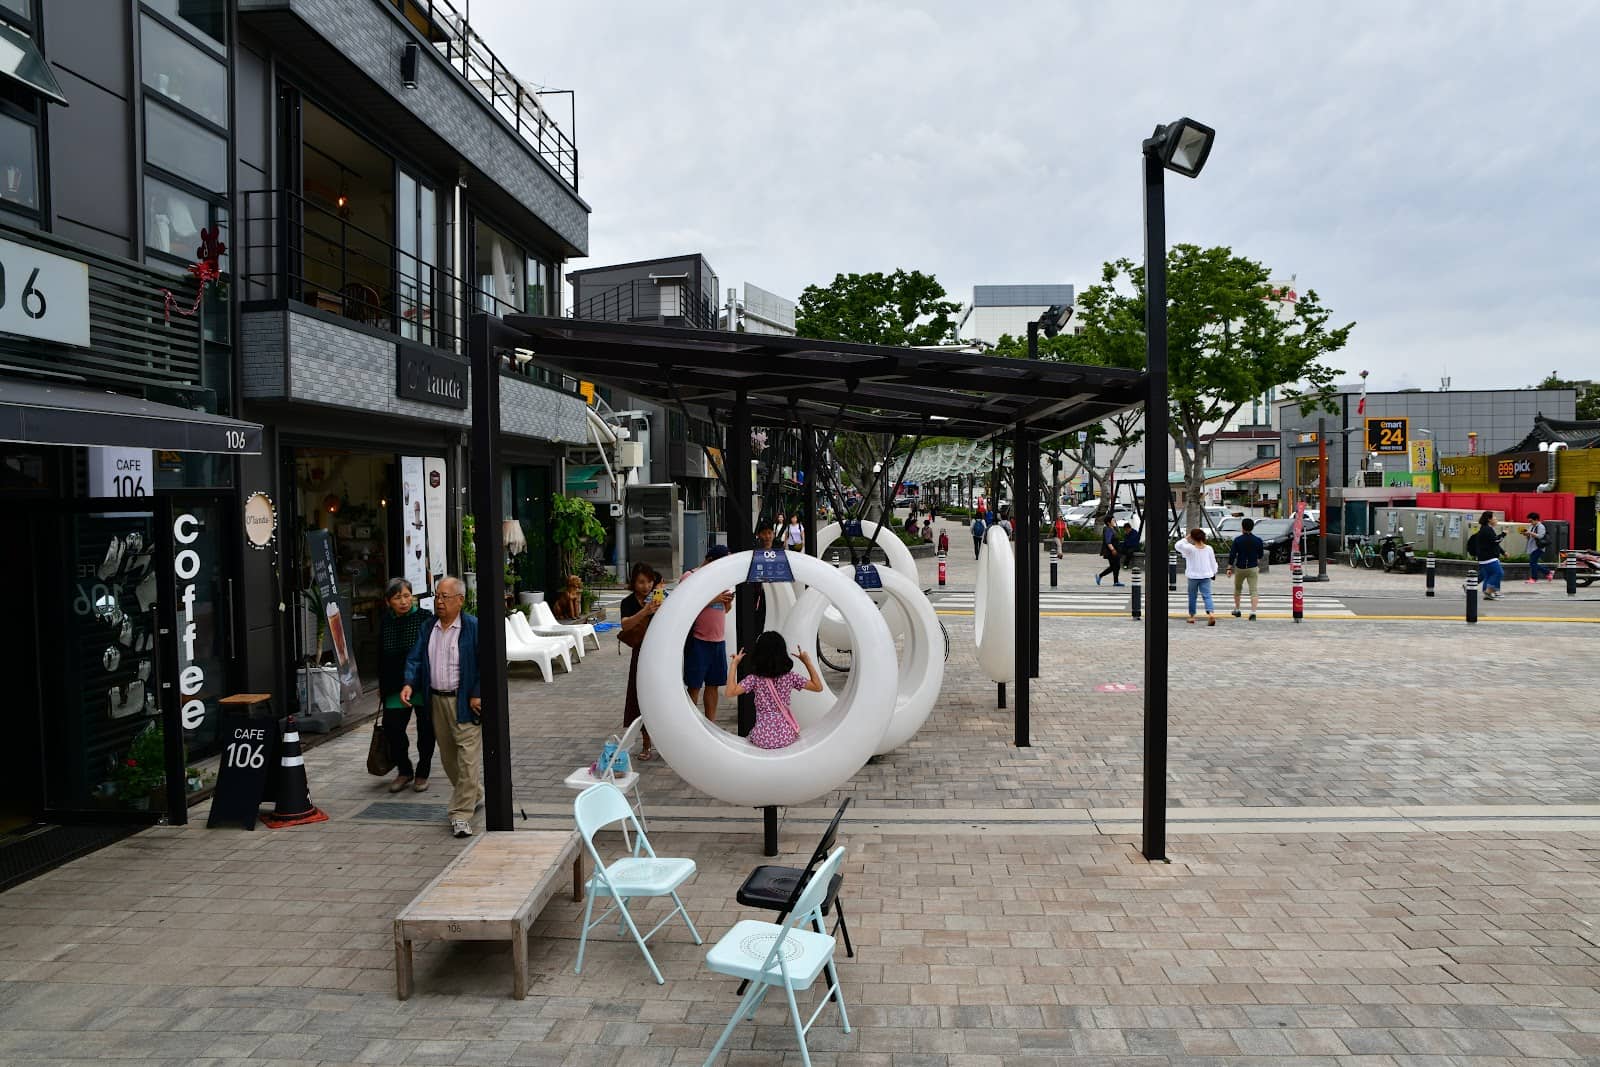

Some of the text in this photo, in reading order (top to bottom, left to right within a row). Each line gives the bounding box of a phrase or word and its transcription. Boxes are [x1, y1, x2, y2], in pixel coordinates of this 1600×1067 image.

[0, 260, 47, 320] 6
[1380, 421, 1403, 429] emart
[225, 430, 246, 449] 106
[1380, 428, 1404, 445] 24
[116, 459, 142, 471] CAFE
[1514, 459, 1531, 475] pick
[112, 475, 146, 497] 106
[173, 513, 206, 730] coffee
[234, 728, 265, 741] CAFE
[226, 743, 265, 769] 106
[447, 923, 462, 933] 106
